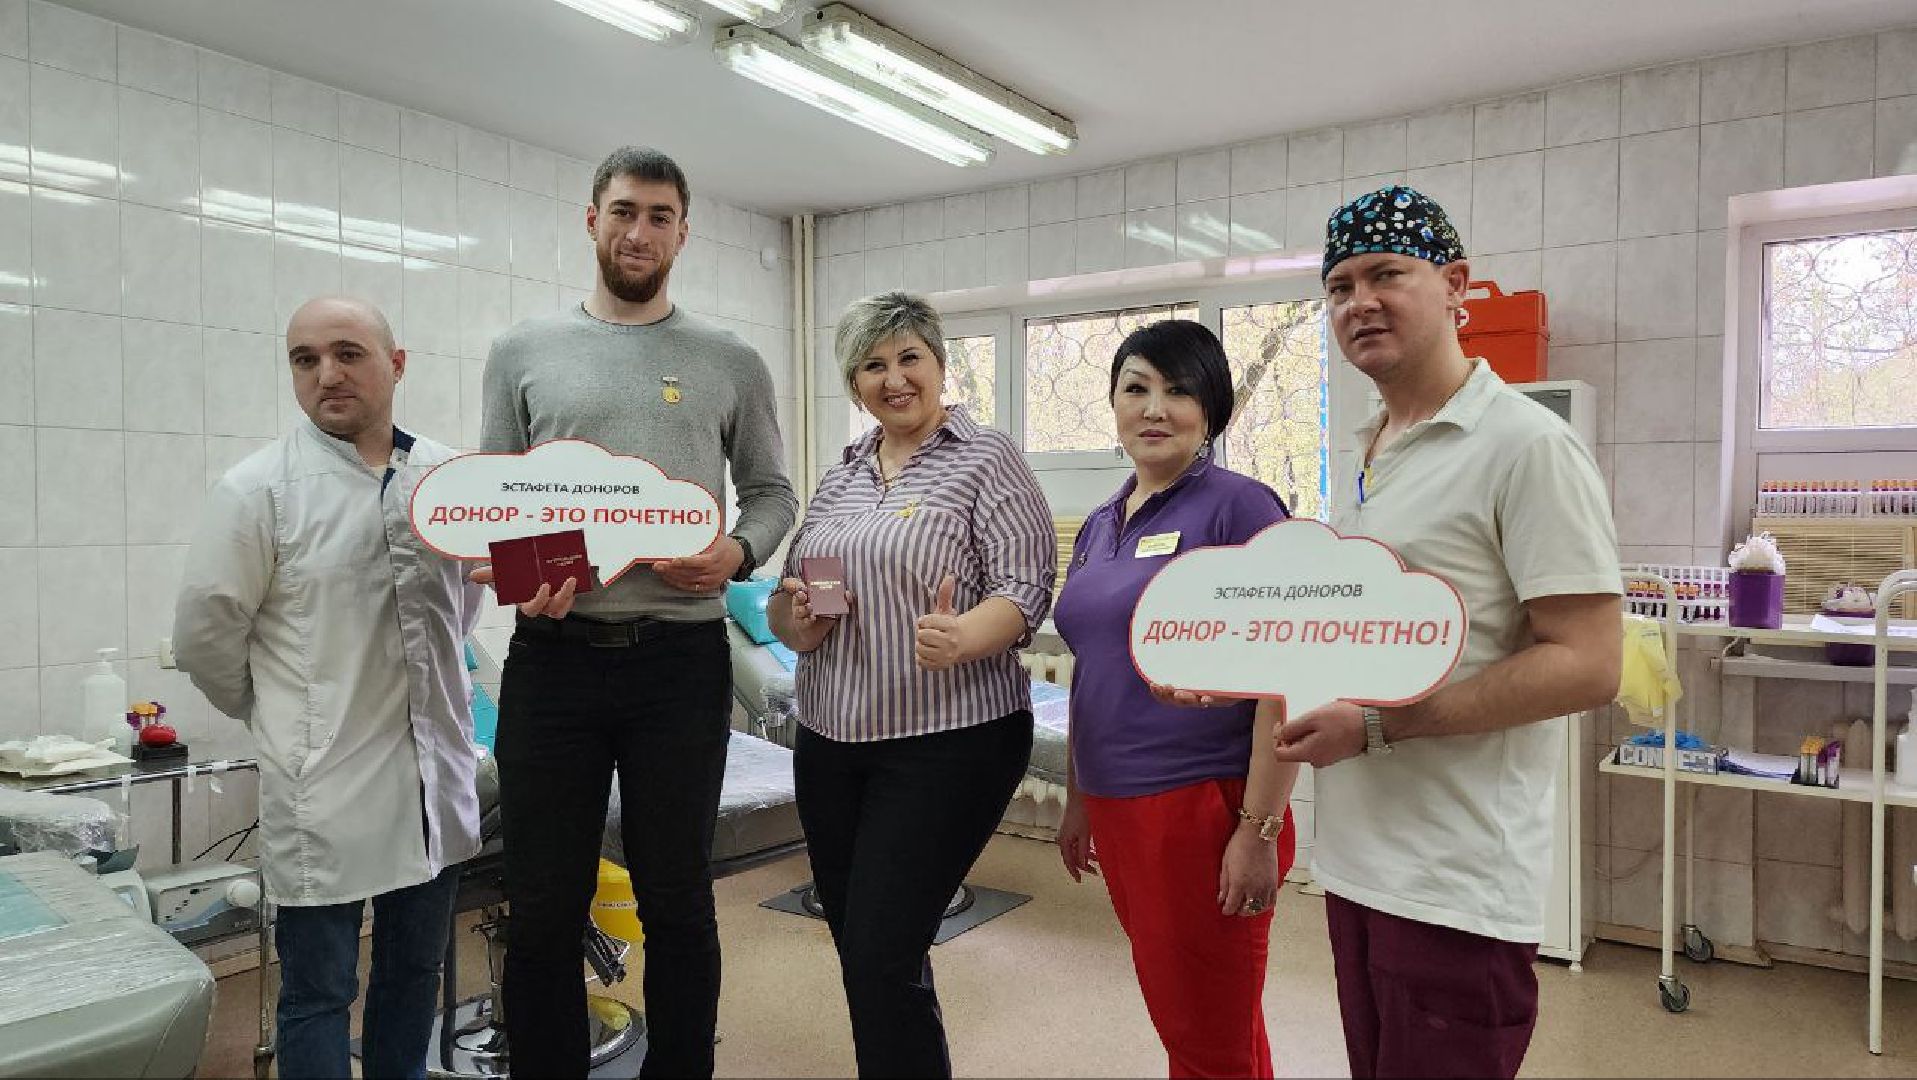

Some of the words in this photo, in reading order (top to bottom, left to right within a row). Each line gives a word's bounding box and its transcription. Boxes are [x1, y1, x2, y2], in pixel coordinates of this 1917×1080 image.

[502, 482, 568, 493] ЭСТАФЕТА
[571, 484, 640, 495] ДОНОРОВ
[428, 506, 519, 525] ДОНОР
[540, 507, 586, 524] ЭТО
[593, 507, 711, 525] ПОЧЕТНО!
[1213, 586, 1281, 599] ЭСТАФЕТА
[1284, 584, 1363, 600] ДОНОРОВ
[1143, 620, 1226, 644] ДОНОР
[1245, 620, 1294, 642] ЭТО
[1300, 620, 1450, 645] ПОЧЕТНО!
[1620, 744, 1717, 774] CONECT
